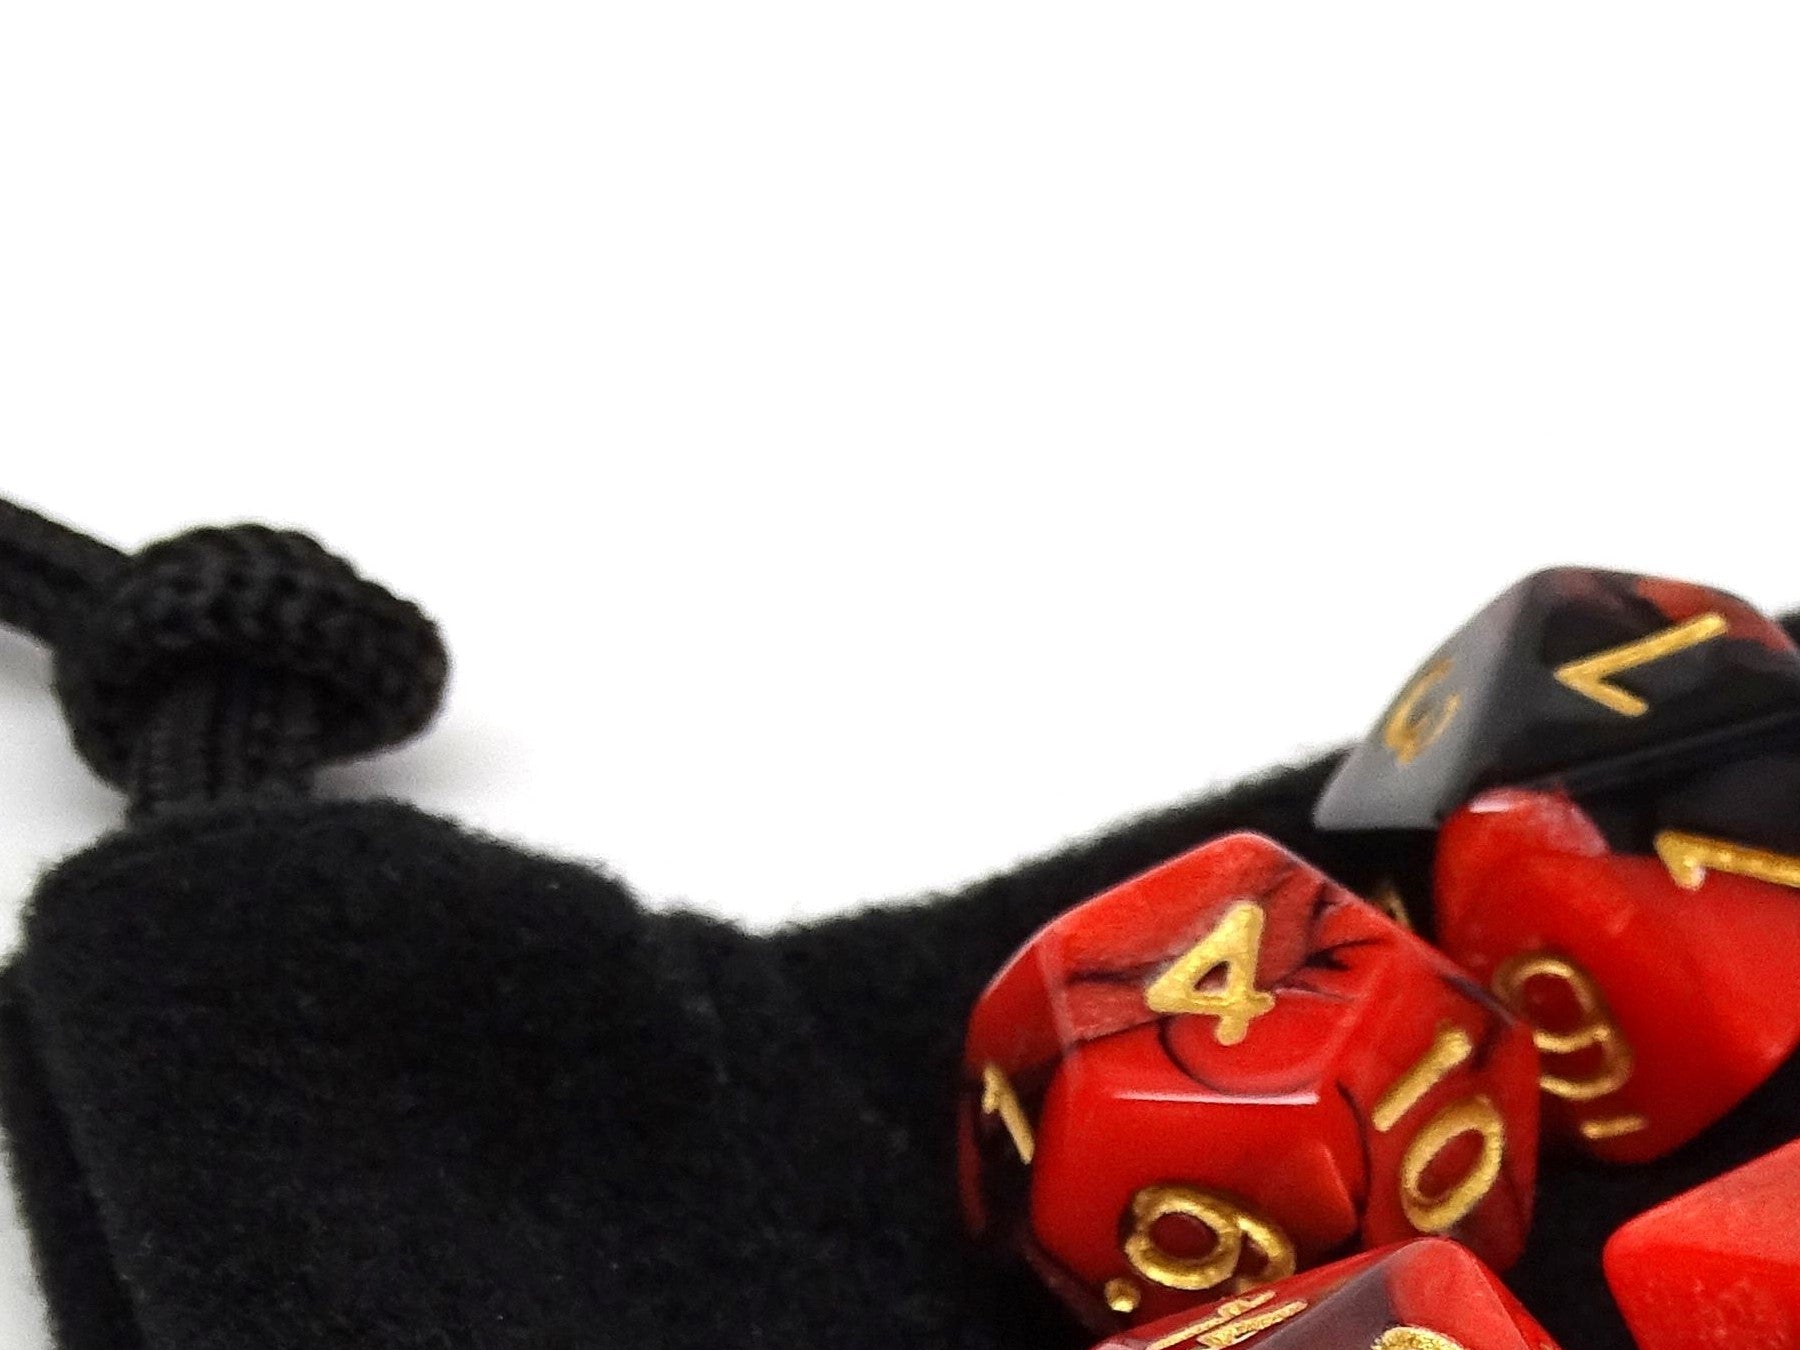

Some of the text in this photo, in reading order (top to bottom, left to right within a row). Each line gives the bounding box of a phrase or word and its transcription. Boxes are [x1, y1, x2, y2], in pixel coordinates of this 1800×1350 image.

[1555, 612, 1728, 716] 7
[1146, 900, 1276, 1046] 4
[982, 1062, 1036, 1165] 1
[1372, 1029, 1505, 1233] 10
